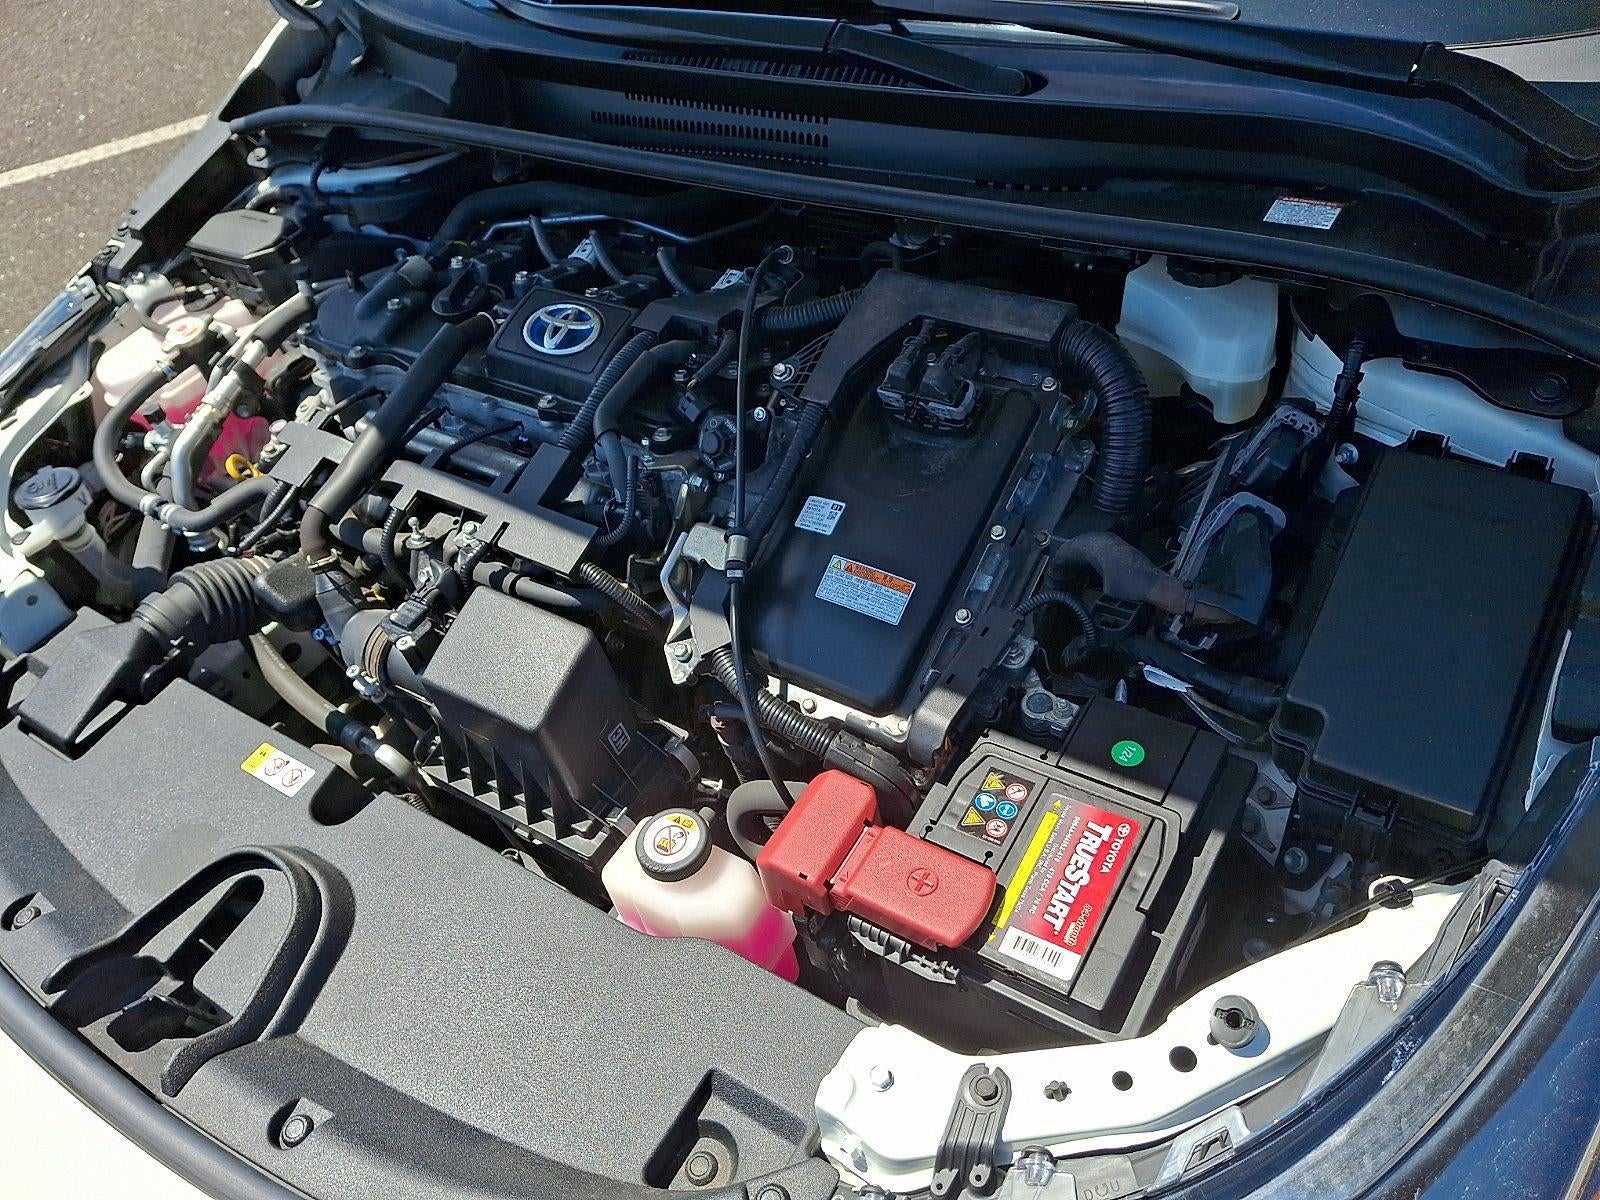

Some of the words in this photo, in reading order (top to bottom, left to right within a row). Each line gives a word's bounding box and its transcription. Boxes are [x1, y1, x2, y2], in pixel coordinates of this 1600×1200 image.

[1118, 746, 1137, 762] 1/24
[1098, 836, 1125, 874] TOYOTA
[1037, 877, 1050, 892] CCA
